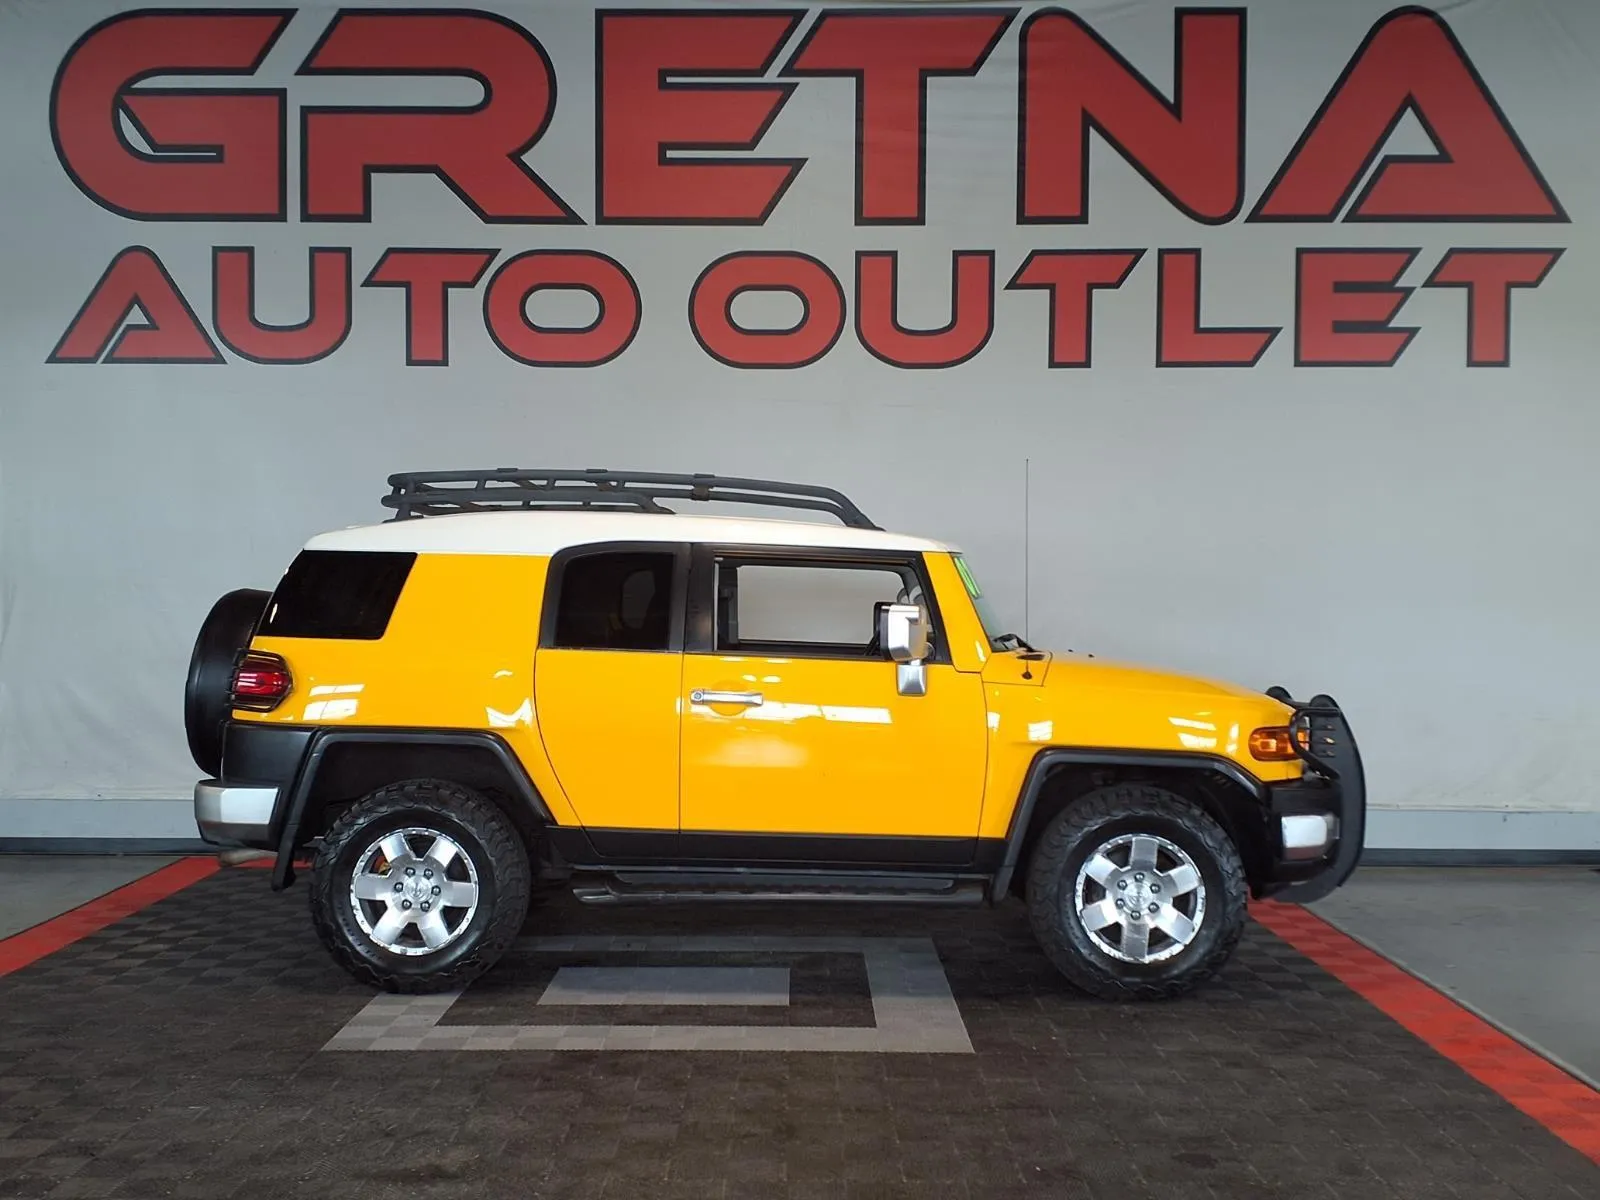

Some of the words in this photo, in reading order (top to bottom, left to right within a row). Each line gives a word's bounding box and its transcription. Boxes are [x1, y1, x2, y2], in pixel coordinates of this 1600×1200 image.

[49, 6, 1571, 226] GRETNA
[45, 245, 642, 367] AUTO
[688, 247, 1566, 369] OUTLET
